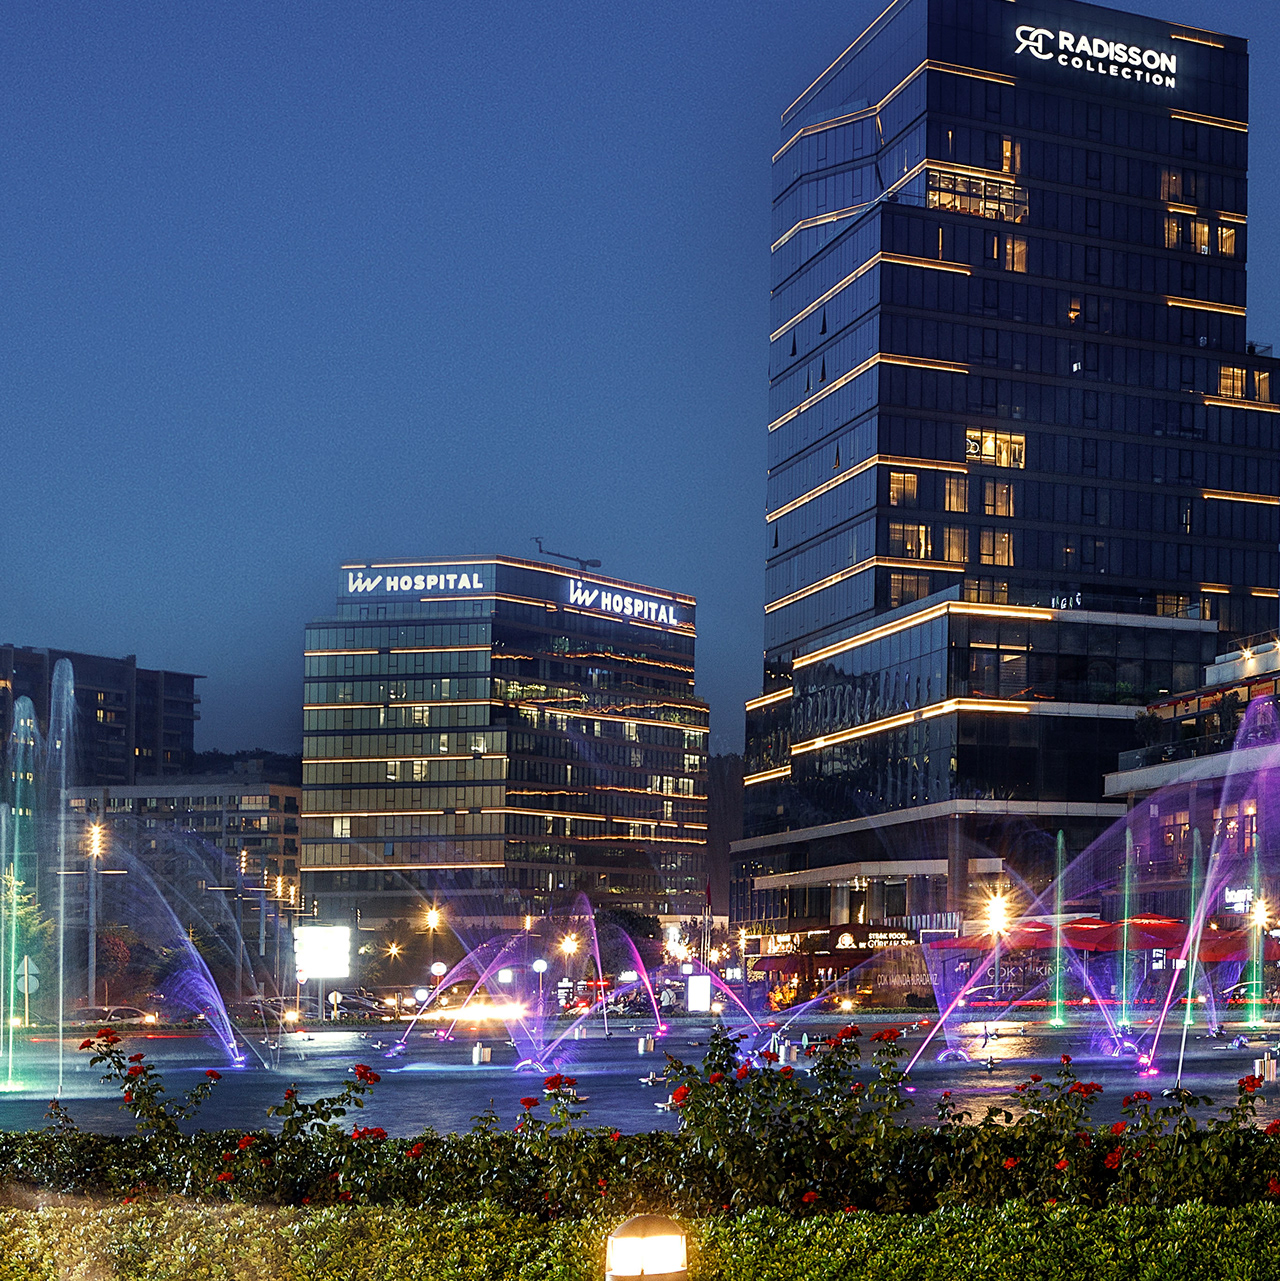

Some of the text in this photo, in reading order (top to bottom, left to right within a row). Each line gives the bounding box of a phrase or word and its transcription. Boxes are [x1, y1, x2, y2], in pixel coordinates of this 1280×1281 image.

[1058, 30, 1177, 73] RADISSON
[1057, 53, 1176, 89] COLLECTION
[386, 573, 484, 591] HOSPITAL
[601, 591, 678, 626] HOSPITAL
